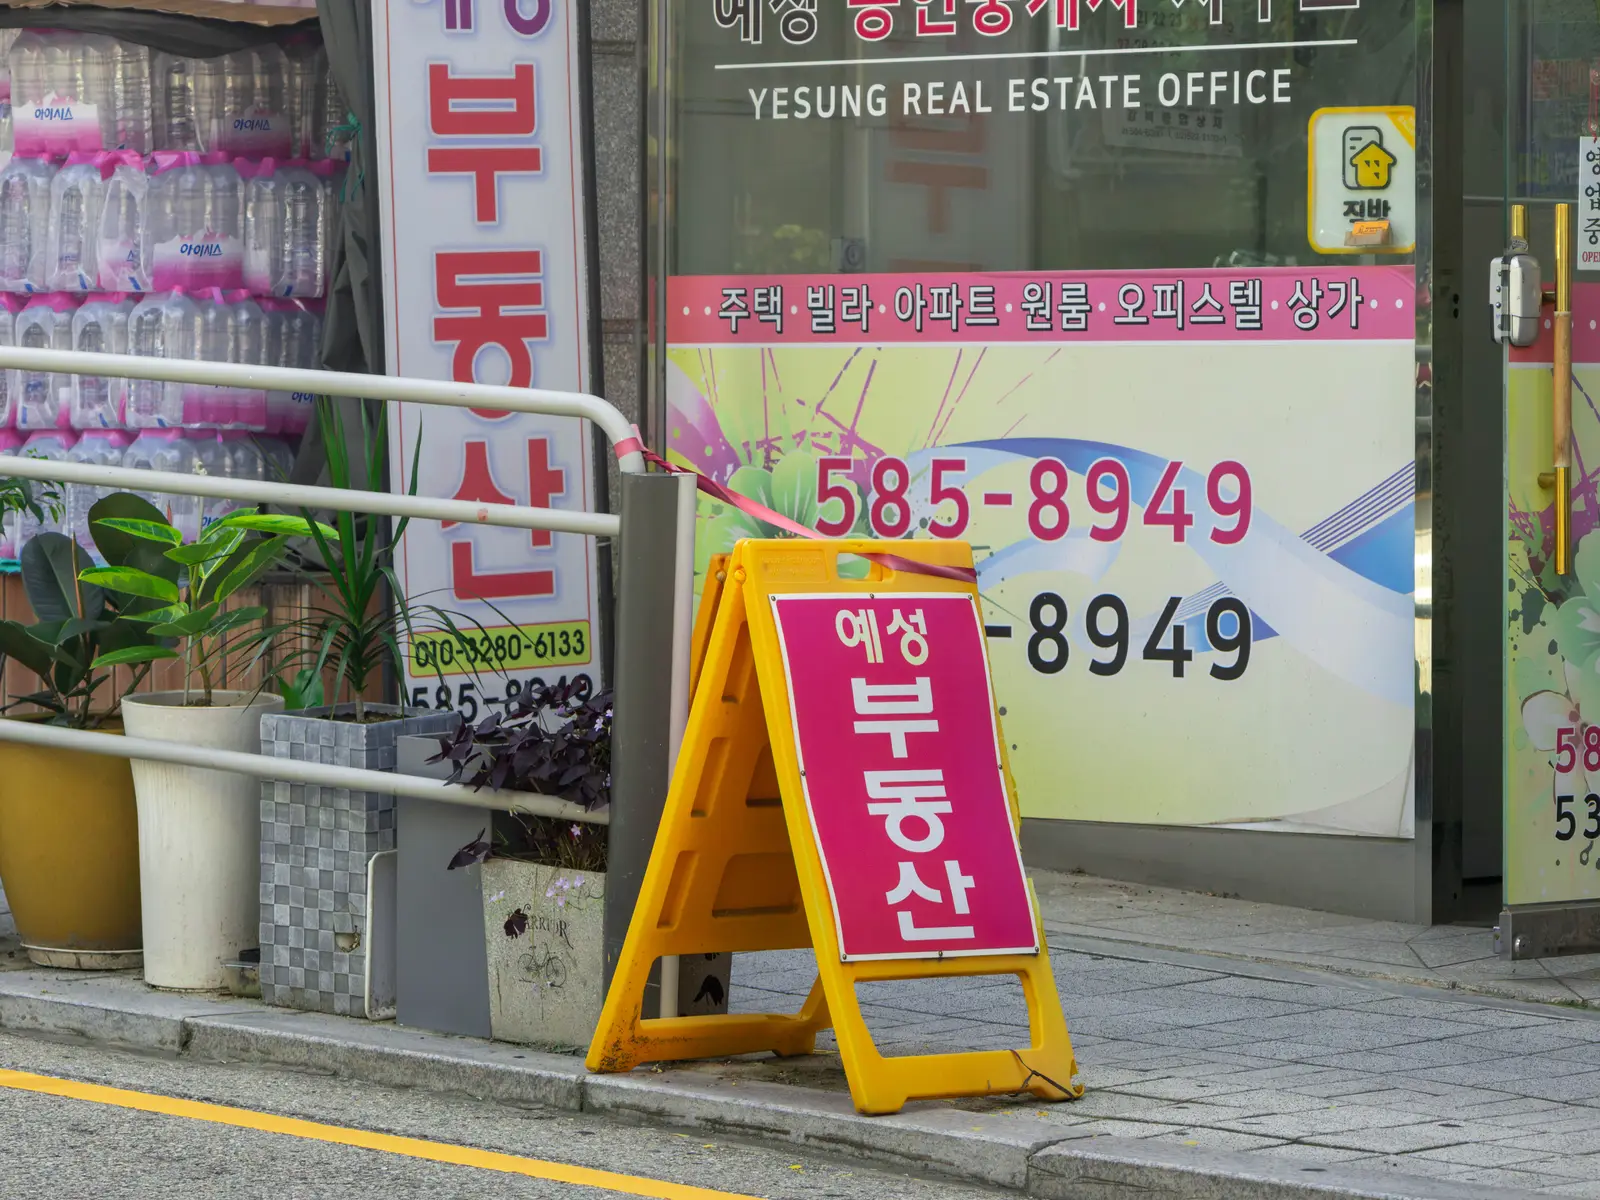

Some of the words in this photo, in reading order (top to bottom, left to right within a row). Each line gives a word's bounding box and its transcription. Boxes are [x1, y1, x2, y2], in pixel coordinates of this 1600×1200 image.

[34, 106, 74, 121] 아이시스
[748, 83, 887, 120] YESUNG
[903, 80, 992, 116] REAL
[1007, 75, 1141, 112] ESTATE
[1158, 69, 1291, 107] OFFICE
[233, 118, 273, 131] 아이시스
[179, 243, 224, 257] 아이시스
[1582, 250, 1600, 263] OPE
[718, 284, 783, 333] 주택
[806, 283, 873, 333] 빌라
[893, 282, 1000, 331] 아파트
[1020, 281, 1092, 331] 원룸
[1113, 278, 1264, 330] 오피스텔
[1286, 277, 1364, 330] 상가
[427, 63, 565, 601] 부동산
[814, 456, 1252, 545] 585-8949
[834, 607, 930, 667] 예성
[850, 676, 976, 942] 부동산
